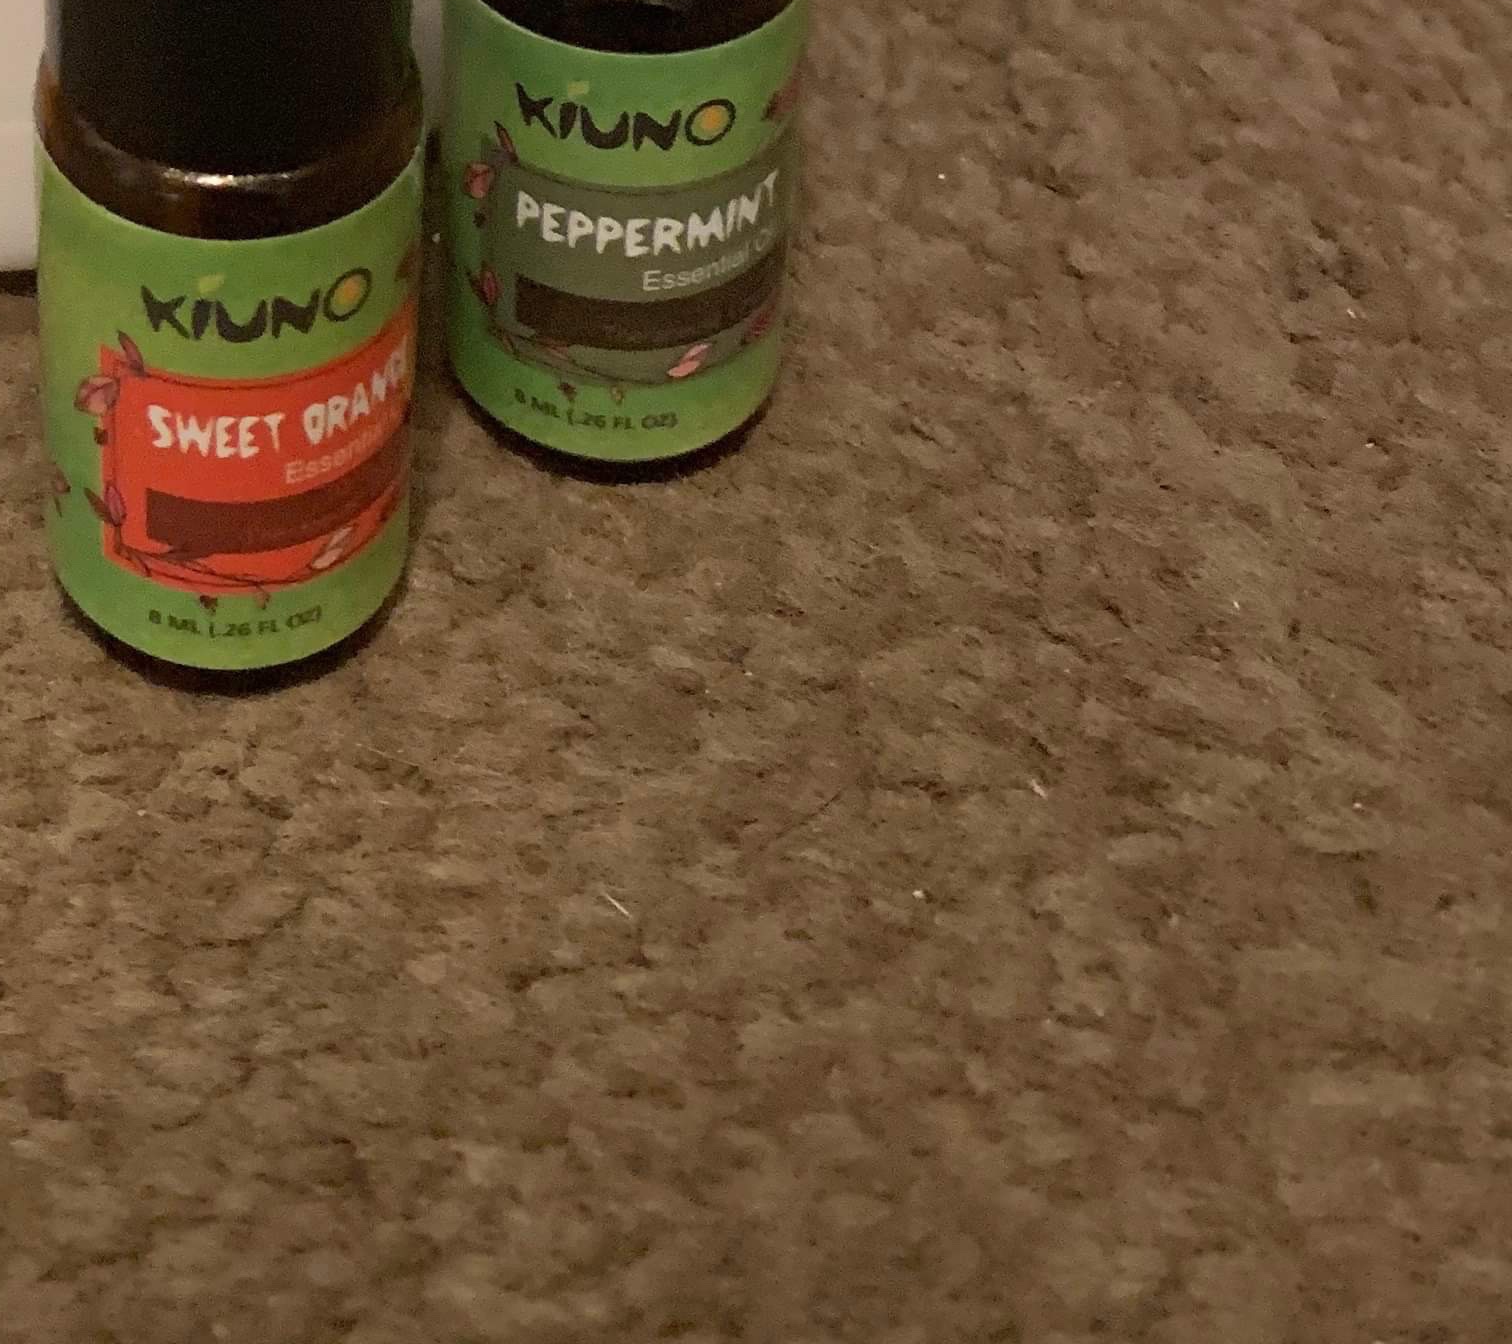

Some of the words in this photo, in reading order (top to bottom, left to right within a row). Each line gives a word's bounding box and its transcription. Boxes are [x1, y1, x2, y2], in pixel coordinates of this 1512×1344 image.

[514, 82, 737, 152] KIUNO
[514, 168, 780, 258] PEPPERMINT
[140, 267, 373, 343] KIUNO
[145, 403, 287, 459] SWEET
[256, 619, 280, 634] FL
